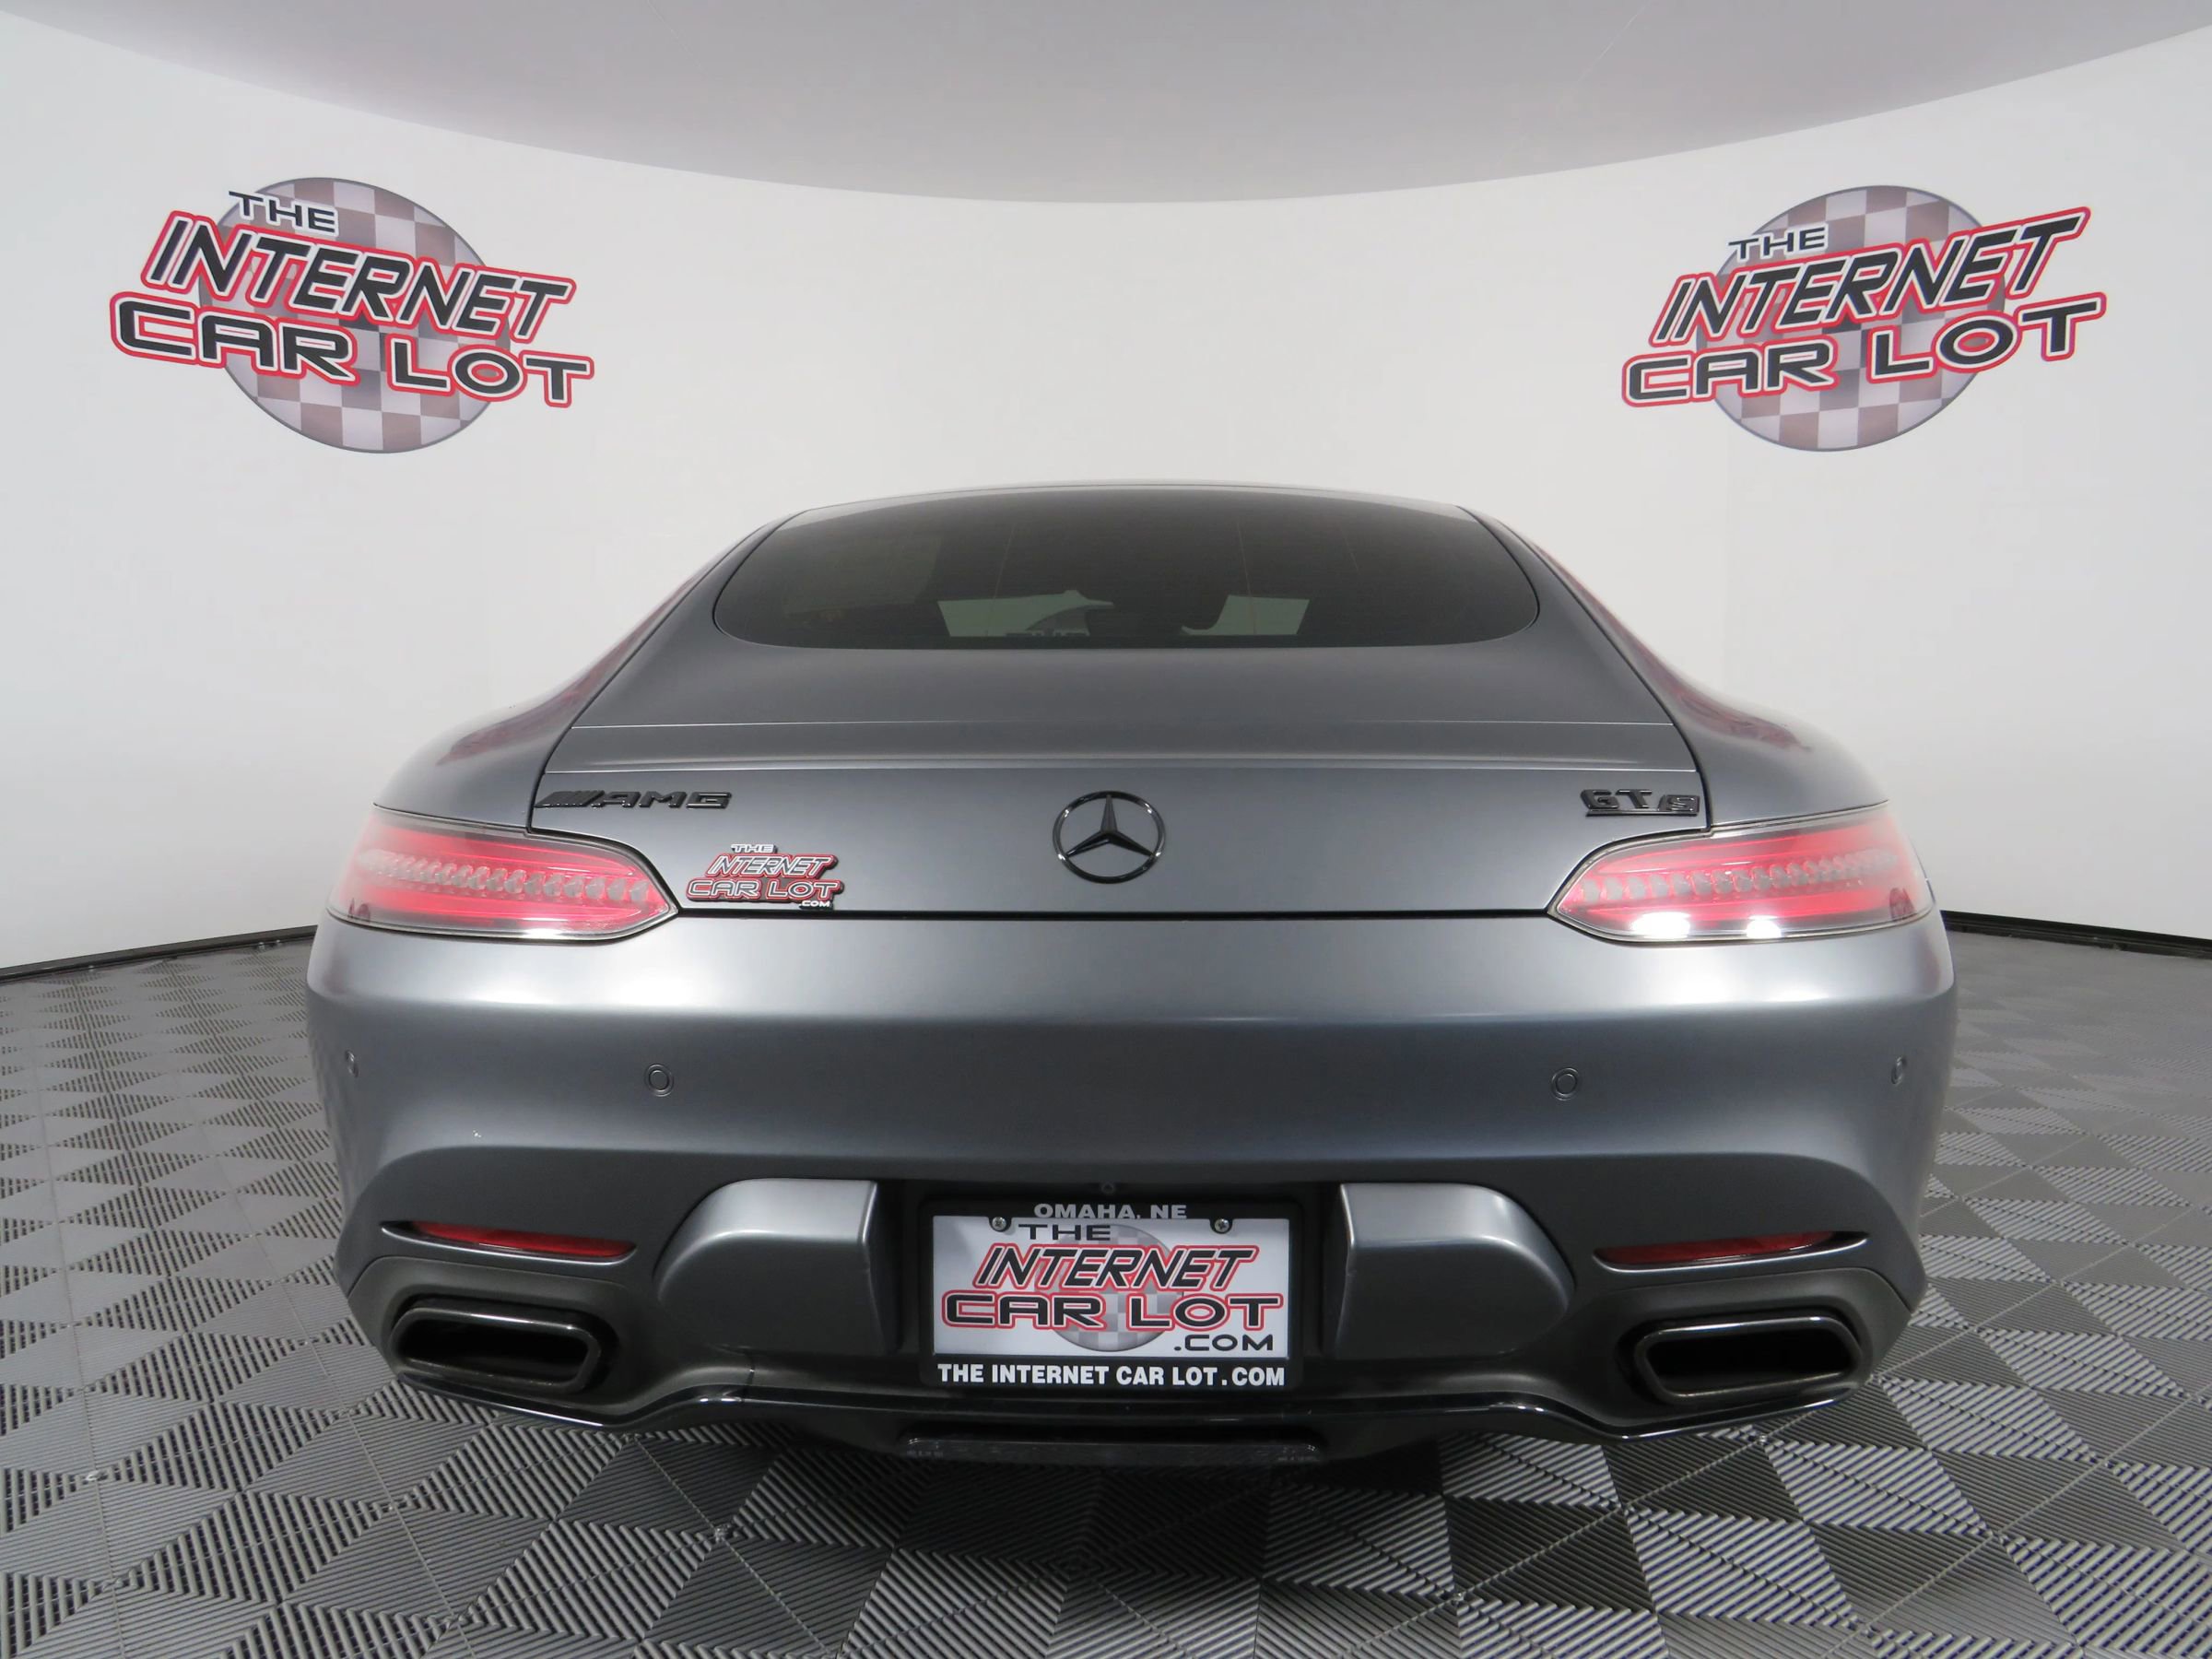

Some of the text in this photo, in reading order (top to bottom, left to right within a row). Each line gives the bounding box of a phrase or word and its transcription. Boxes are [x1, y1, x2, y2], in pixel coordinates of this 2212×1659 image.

[229, 191, 338, 235] THE
[1727, 224, 1828, 260] THE
[143, 213, 573, 340] INTERNET
[1653, 210, 2087, 342] INTERNET
[114, 295, 591, 405] CAR LOT
[1625, 296, 2102, 403] CAR LOT
[590, 792, 732, 808] AMG
[731, 843, 775, 853] THE
[707, 855, 834, 877] INTERNET
[688, 879, 840, 899] CAR LOT
[1150, 1205, 1187, 1219] NE
[1018, 1224, 1111, 1241] THE
[975, 1245, 1258, 1289] INTERNET
[944, 1292, 1281, 1329] CAR LOT
[1173, 1334, 1274, 1351] .COM
[937, 1363, 983, 1382] THE
[992, 1364, 1110, 1384] INTERNET
[1116, 1367, 1164, 1385] CAR
